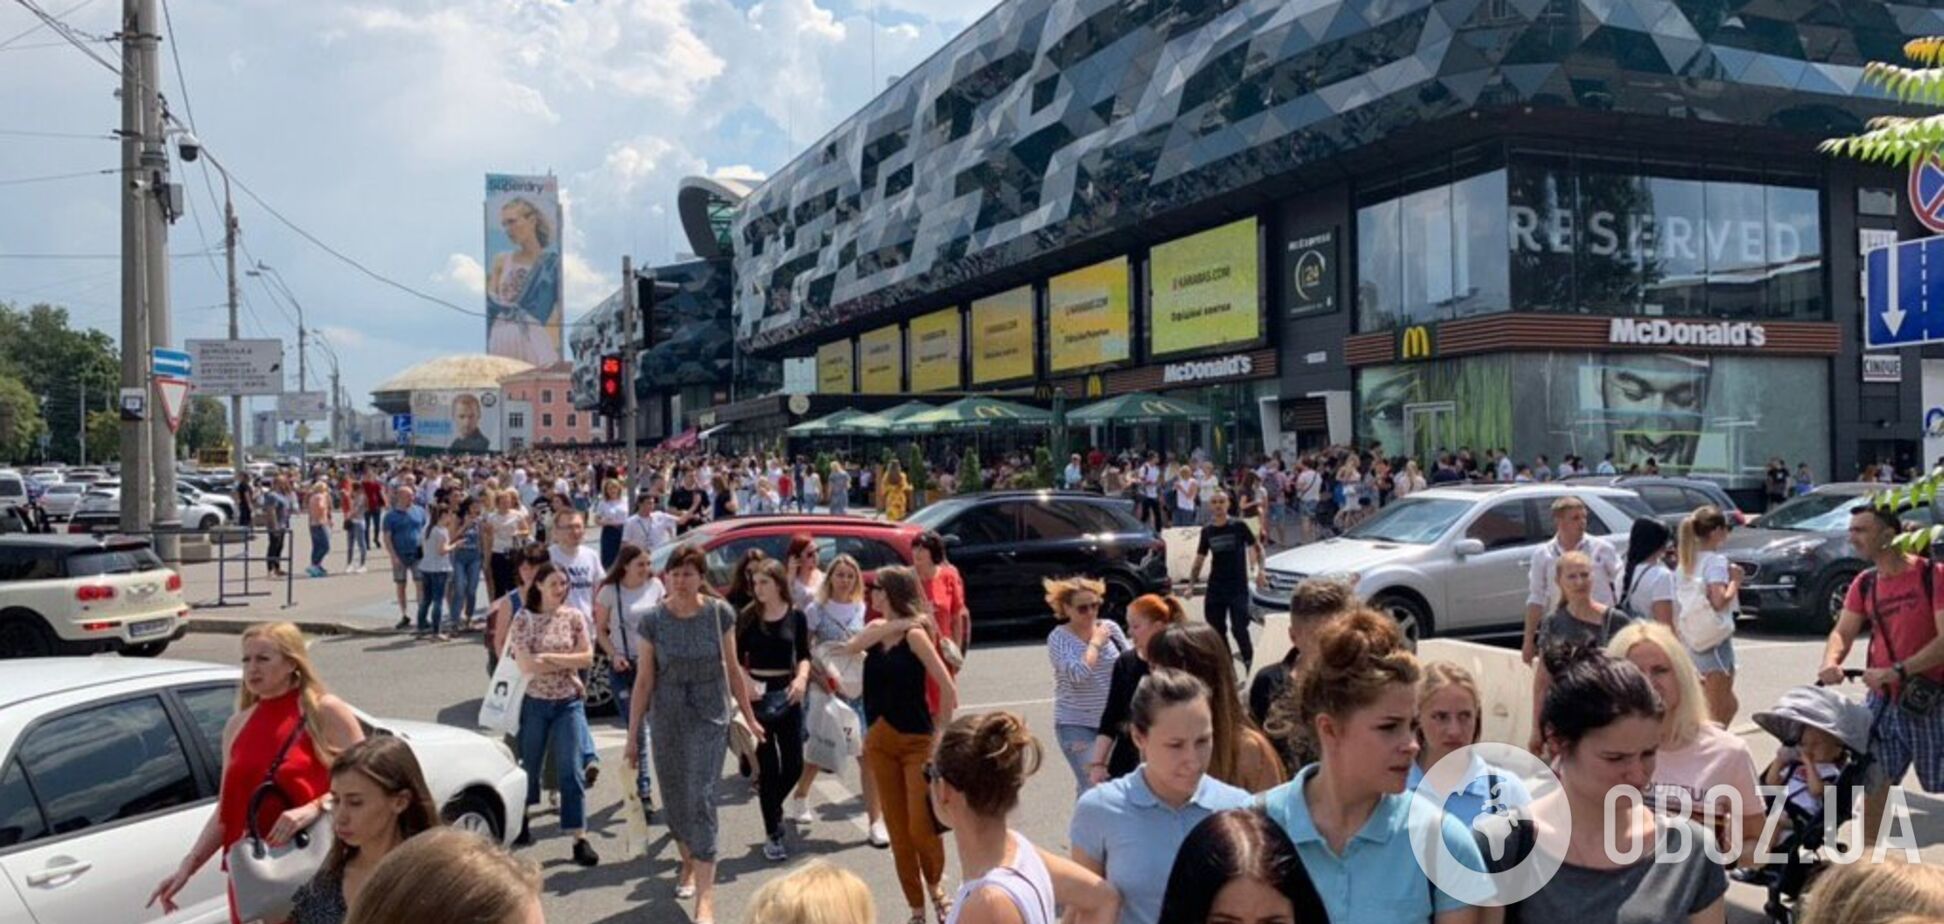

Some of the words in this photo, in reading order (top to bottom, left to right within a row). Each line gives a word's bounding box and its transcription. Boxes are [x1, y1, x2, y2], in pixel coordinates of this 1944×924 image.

[1508, 206, 1799, 262] RESERVED
[1610, 318, 1766, 346] McDonald's
[1163, 355, 1252, 383] McDonald's
